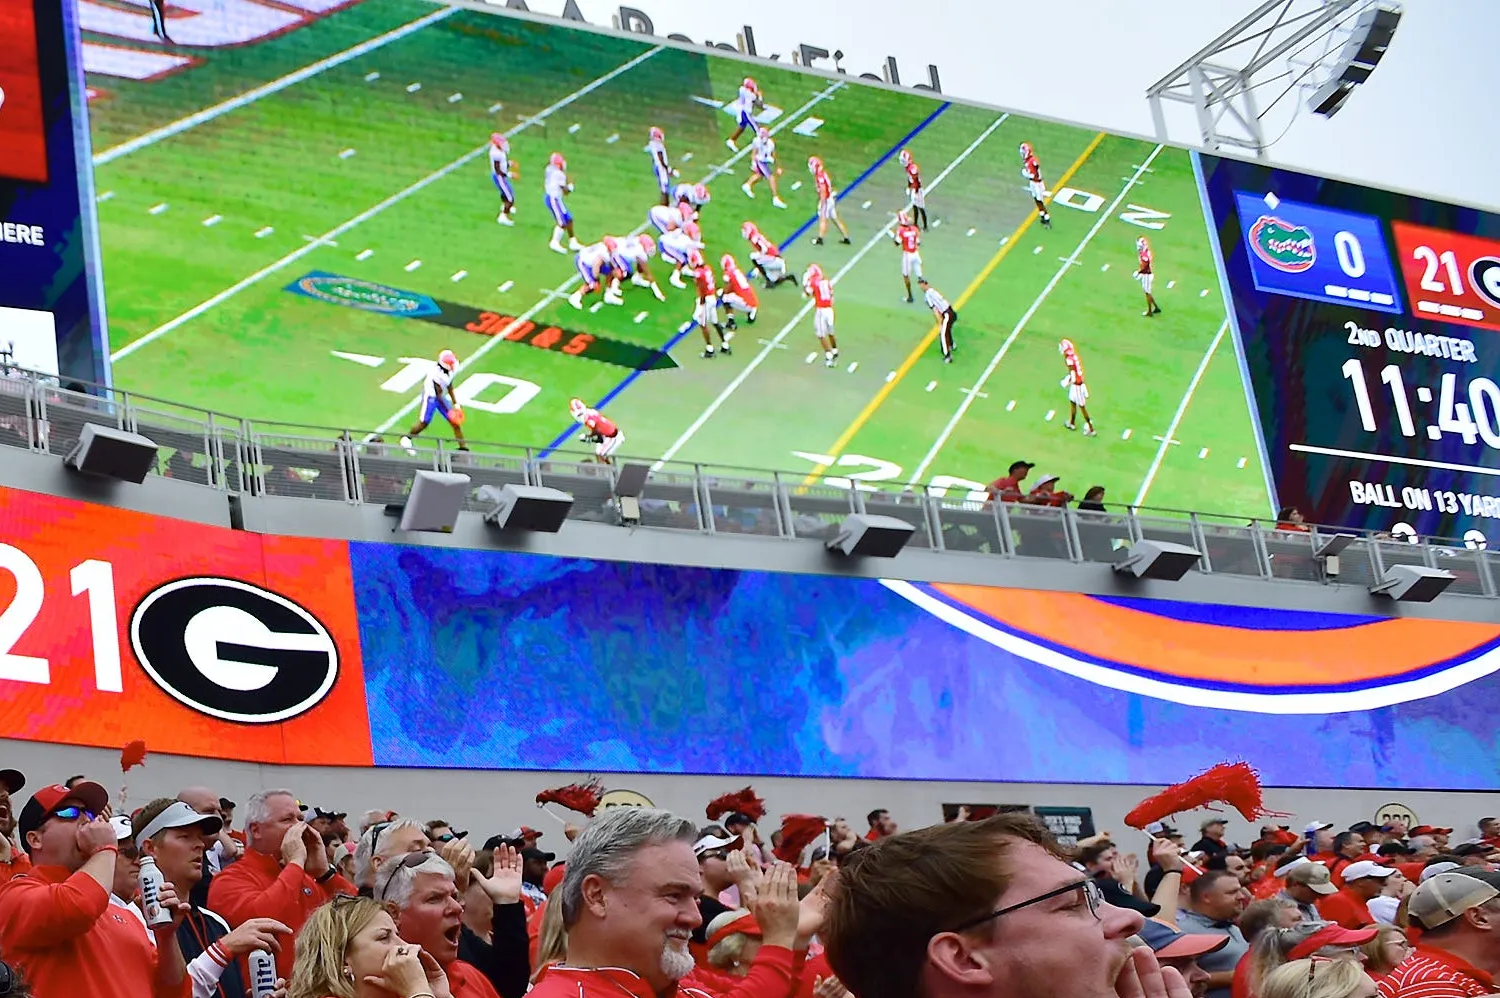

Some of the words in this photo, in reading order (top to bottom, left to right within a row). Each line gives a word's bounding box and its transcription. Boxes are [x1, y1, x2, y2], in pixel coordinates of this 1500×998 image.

[1334, 231, 1366, 278] 0
[1413, 246, 1464, 296] 21
[1344, 321, 1382, 348] 2ND
[1384, 327, 1478, 363] QUARTER
[1342, 358, 1500, 450] 11:40
[1349, 480, 1403, 508] BALL
[1402, 487, 1433, 512] ON
[1433, 490, 1459, 514] 13
